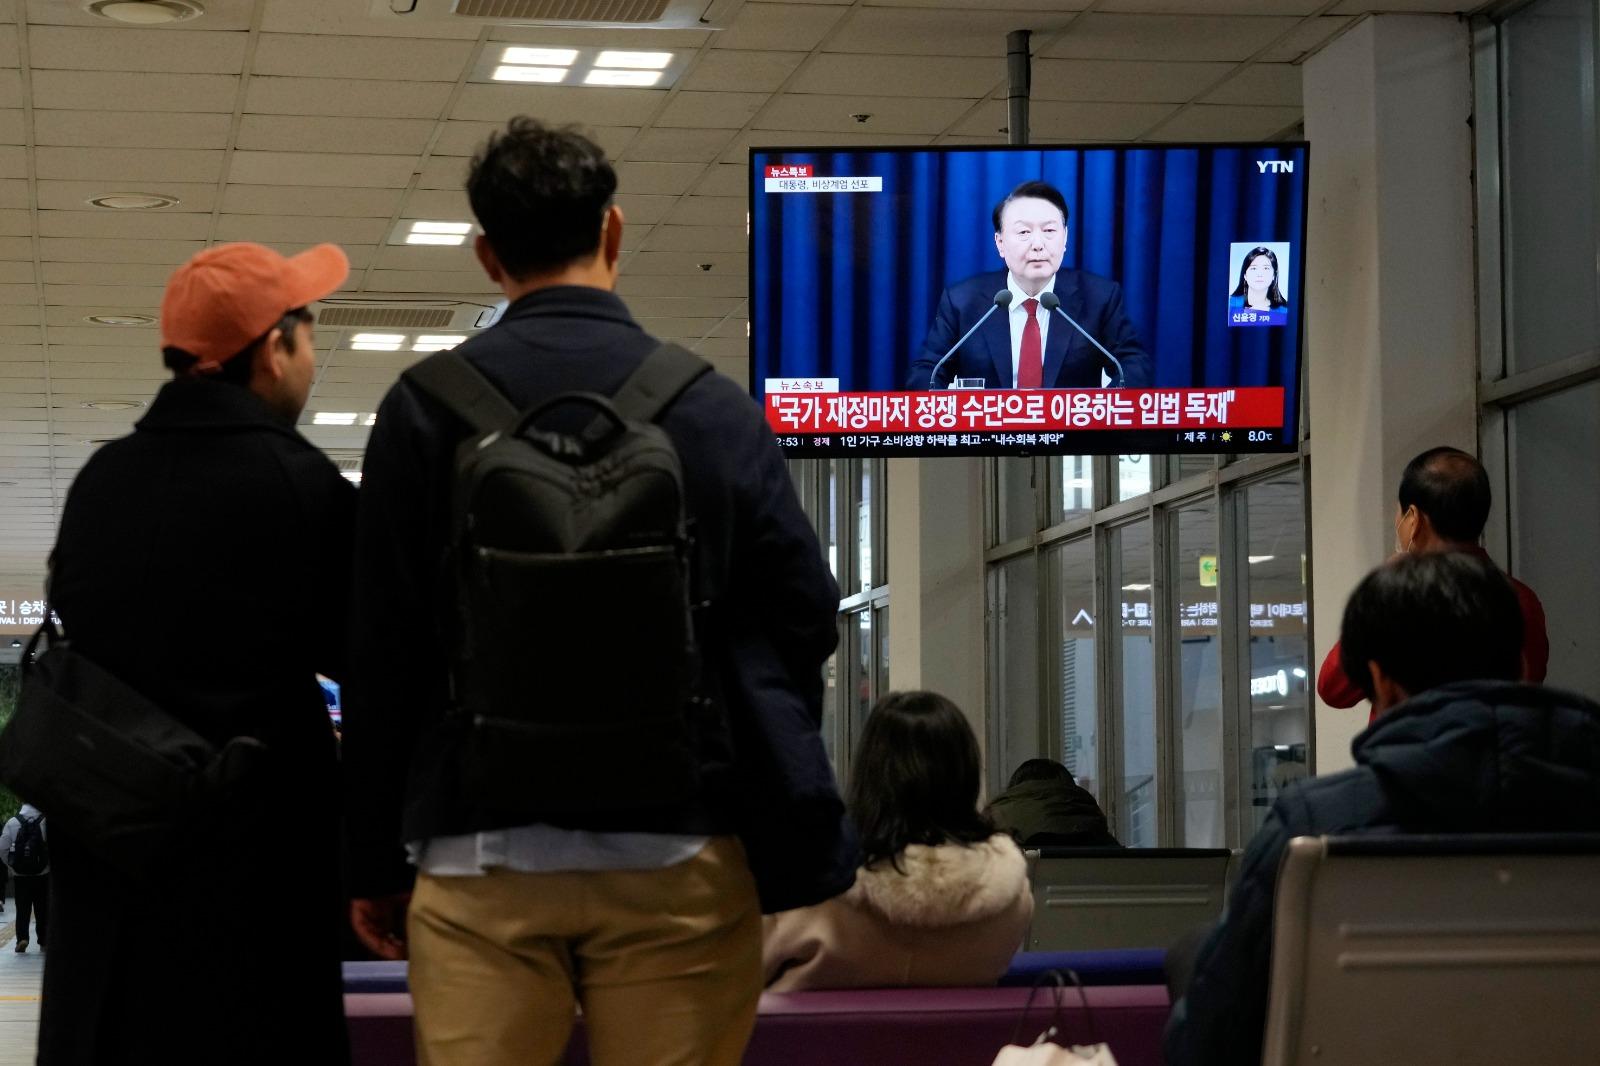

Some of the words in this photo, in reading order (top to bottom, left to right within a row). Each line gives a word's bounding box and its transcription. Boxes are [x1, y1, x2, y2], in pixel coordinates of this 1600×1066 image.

[771, 167, 807, 178] 뉴스특보
[1256, 161, 1293, 173] YTN
[812, 180, 848, 190] 비상계엄
[850, 180, 869, 190] 선포
[780, 380, 824, 391] 뉴스속보
[771, 395, 822, 429] "국가
[825, 395, 909, 429] 재정마저
[914, 395, 956, 428] 정쟁
[961, 394, 1046, 428] 수단으로
[1050, 393, 1134, 426] 이용하는
[1139, 393, 1179, 425] 입법
[1184, 390, 1235, 425] 독재"
[813, 437, 830, 446] 경제
[840, 436, 857, 447] 1인
[859, 435, 880, 447] 가구
[883, 435, 924, 447] 소비성향
[1038, 433, 1064, 445] 제약"
[1185, 432, 1207, 443] 제주
